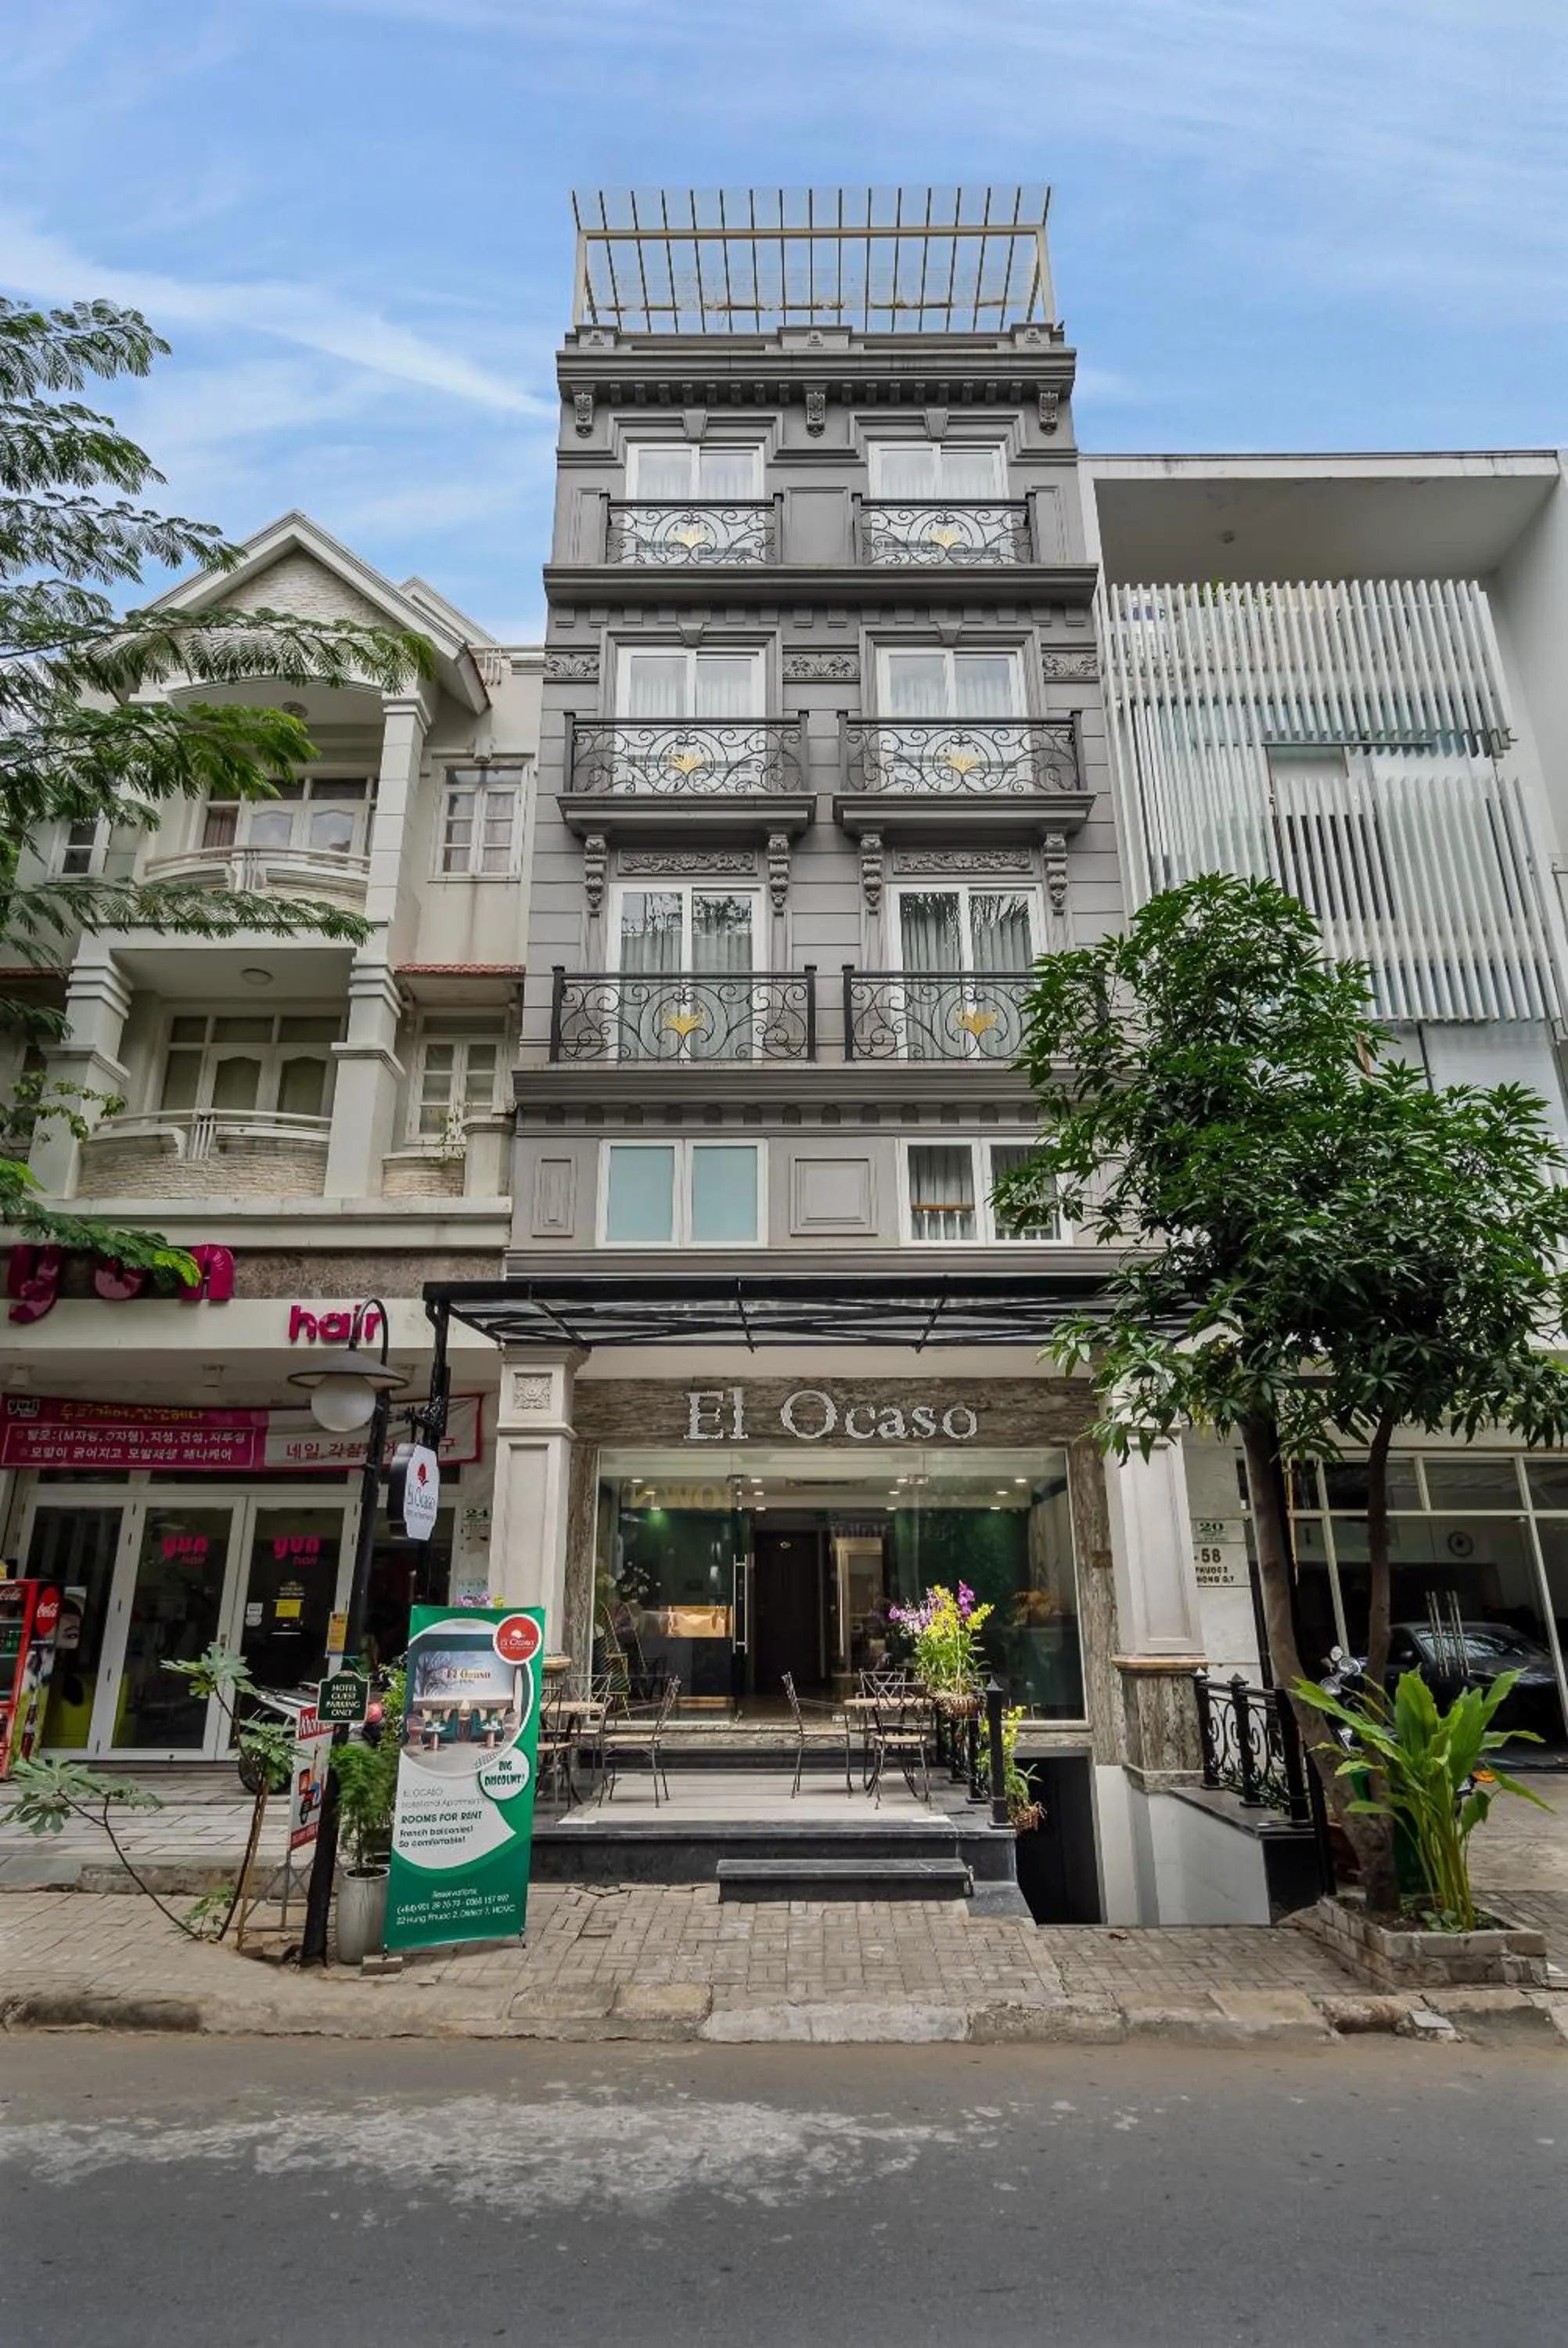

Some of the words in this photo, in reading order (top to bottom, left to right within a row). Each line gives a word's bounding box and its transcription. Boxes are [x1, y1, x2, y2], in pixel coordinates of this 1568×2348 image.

[289, 1303, 383, 1341] hair
[685, 1388, 749, 1440] El
[779, 1389, 979, 1440] Ocaso
[1200, 1522, 1224, 1532] 20
[274, 1536, 321, 1559] yun
[401, 1813, 437, 1824] ROOMS
[439, 1812, 458, 1822] FOR
[461, 1810, 483, 1820] RENT
